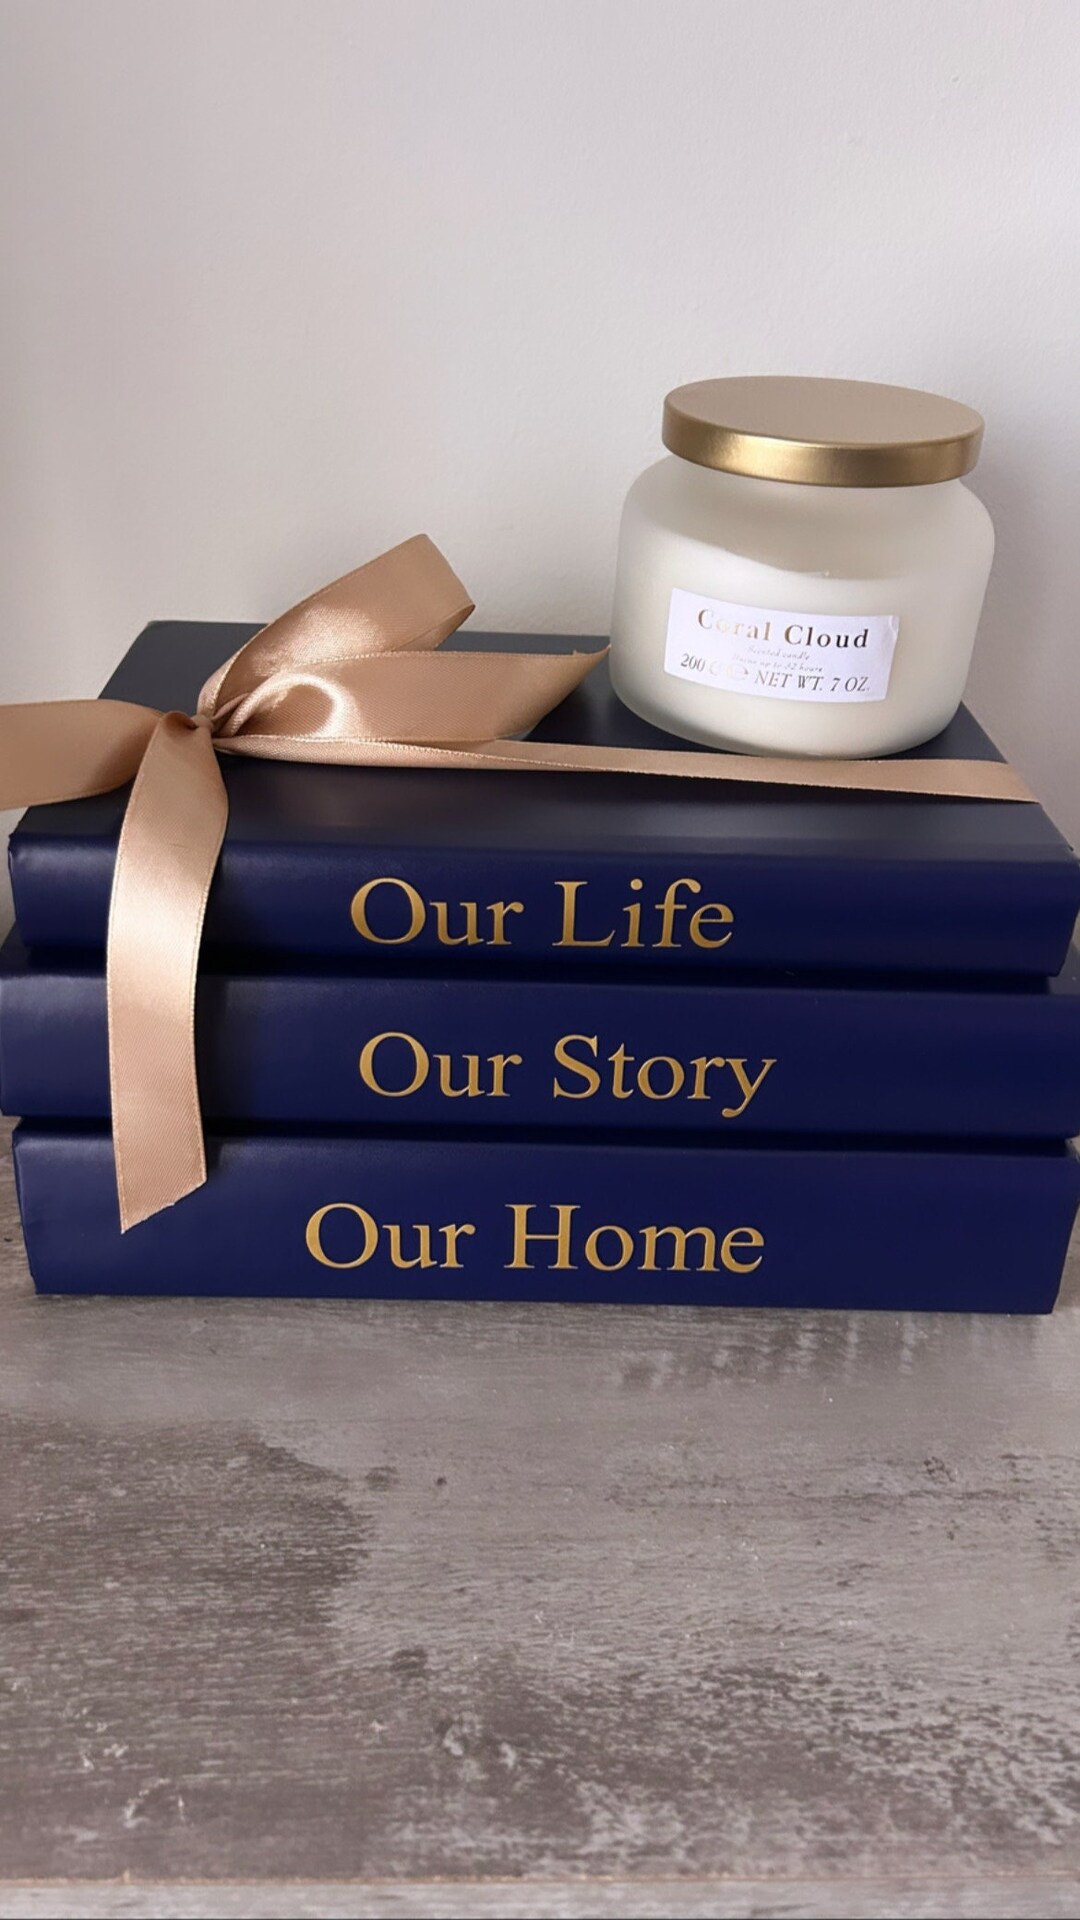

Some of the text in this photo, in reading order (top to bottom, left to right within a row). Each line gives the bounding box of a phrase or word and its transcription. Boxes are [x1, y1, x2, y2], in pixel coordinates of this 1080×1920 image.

[697, 608, 869, 649] Coral Cloud
[680, 653, 706, 672] 200
[754, 670, 793, 689] NET
[797, 675, 823, 692] WT.
[830, 677, 841, 692] 7
[350, 877, 735, 949] Our Life
[358, 1031, 777, 1118] Our Story
[305, 1202, 765, 1274] Our Home
